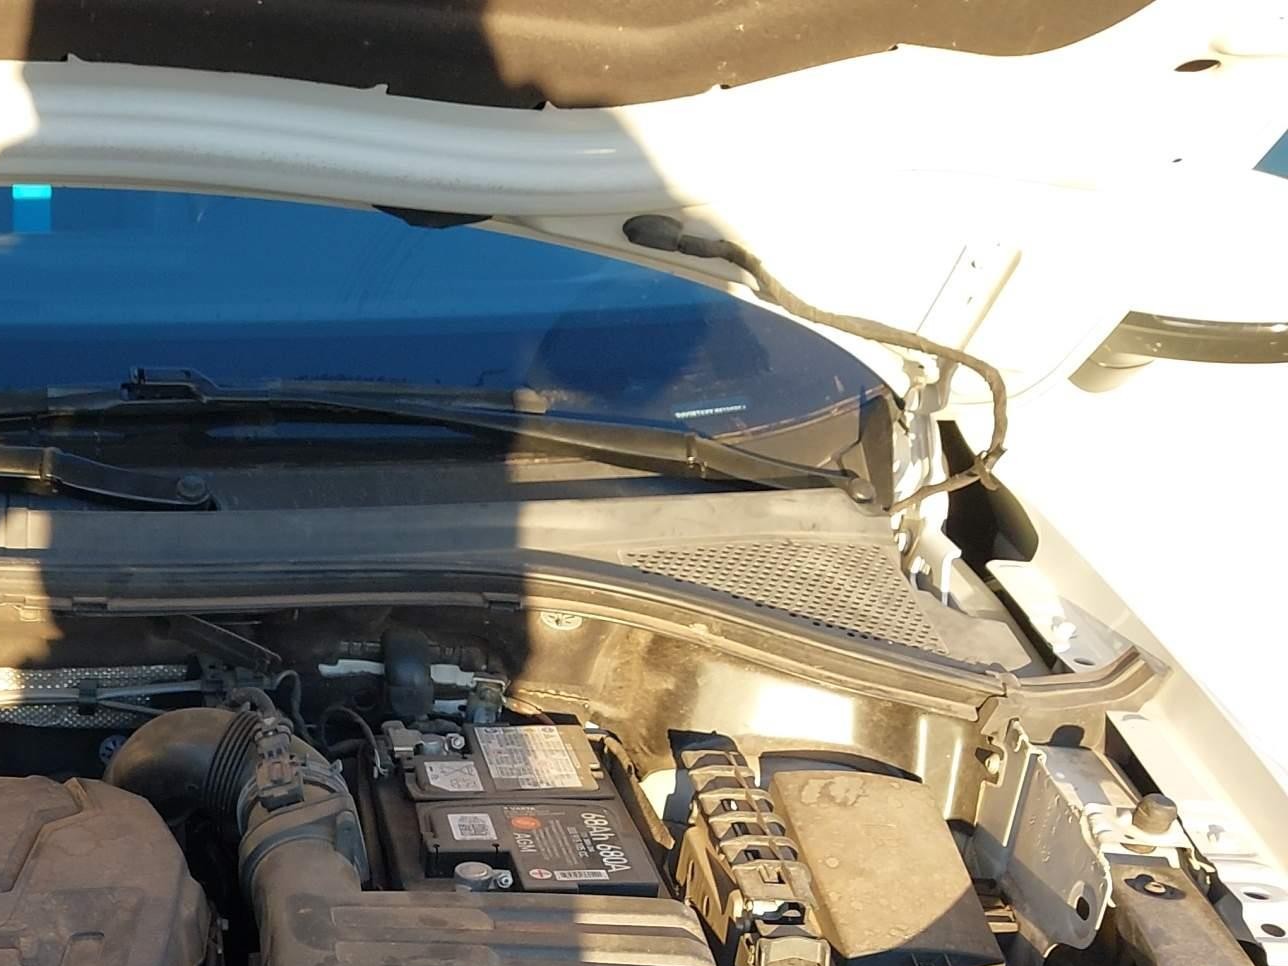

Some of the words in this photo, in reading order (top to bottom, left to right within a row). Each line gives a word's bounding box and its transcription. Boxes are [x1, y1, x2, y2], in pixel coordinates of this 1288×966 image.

[580, 812, 616, 841] 68Ah
[513, 832, 537, 853] AGM
[596, 843, 632, 873] 680A
